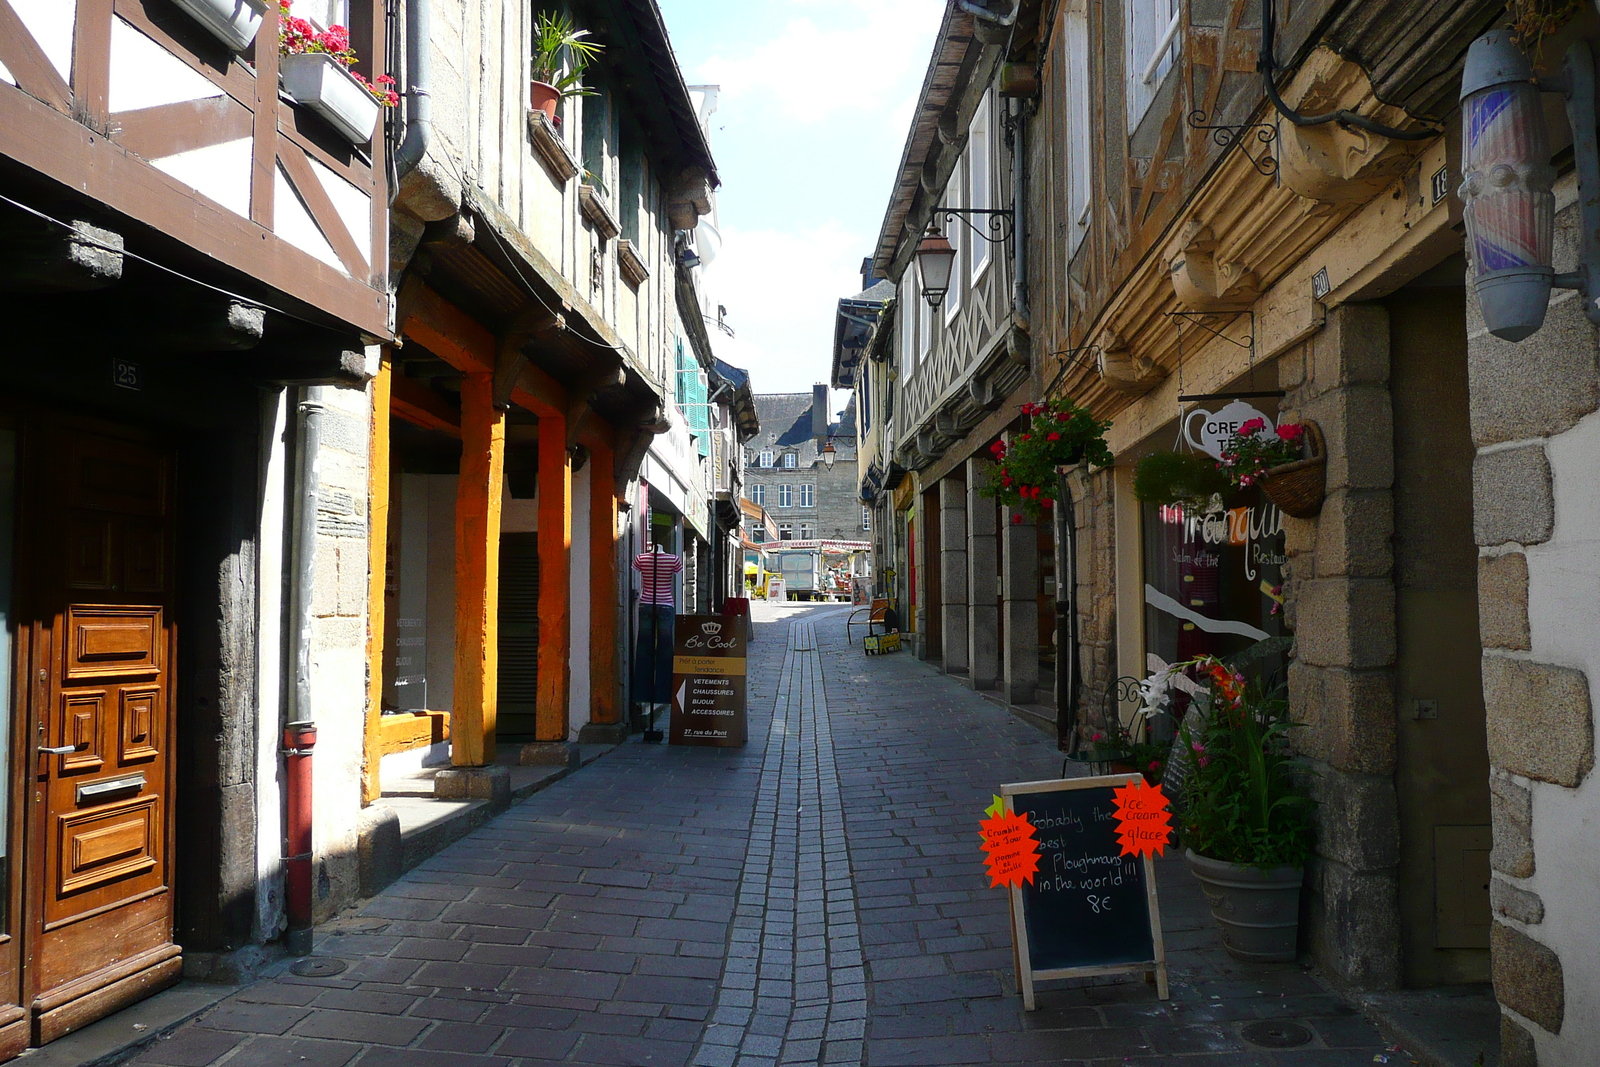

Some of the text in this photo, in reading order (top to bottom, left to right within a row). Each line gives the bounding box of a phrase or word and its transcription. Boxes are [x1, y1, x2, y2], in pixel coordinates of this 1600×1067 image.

[1314, 274, 1326, 296] 20
[118, 364, 137, 384] 25
[684, 635, 737, 649] Be Cool
[694, 666, 724, 674] Tendance
[697, 658, 716, 667] porter
[693, 678, 730, 686] VETEMENTS
[692, 688, 734, 696] CHAUSSURES
[692, 698, 715, 706] BIJOUX
[692, 708, 735, 716] ACCESSOIRES
[1028, 806, 1112, 833] Probably the
[1038, 834, 1066, 850] best
[1128, 826, 1163, 846] glace
[1003, 860, 1011, 868] et
[1053, 851, 1122, 874] Ploughmans
[1039, 876, 1051, 893] in
[1055, 874, 1076, 892] the
[1086, 894, 1112, 914] 8€
